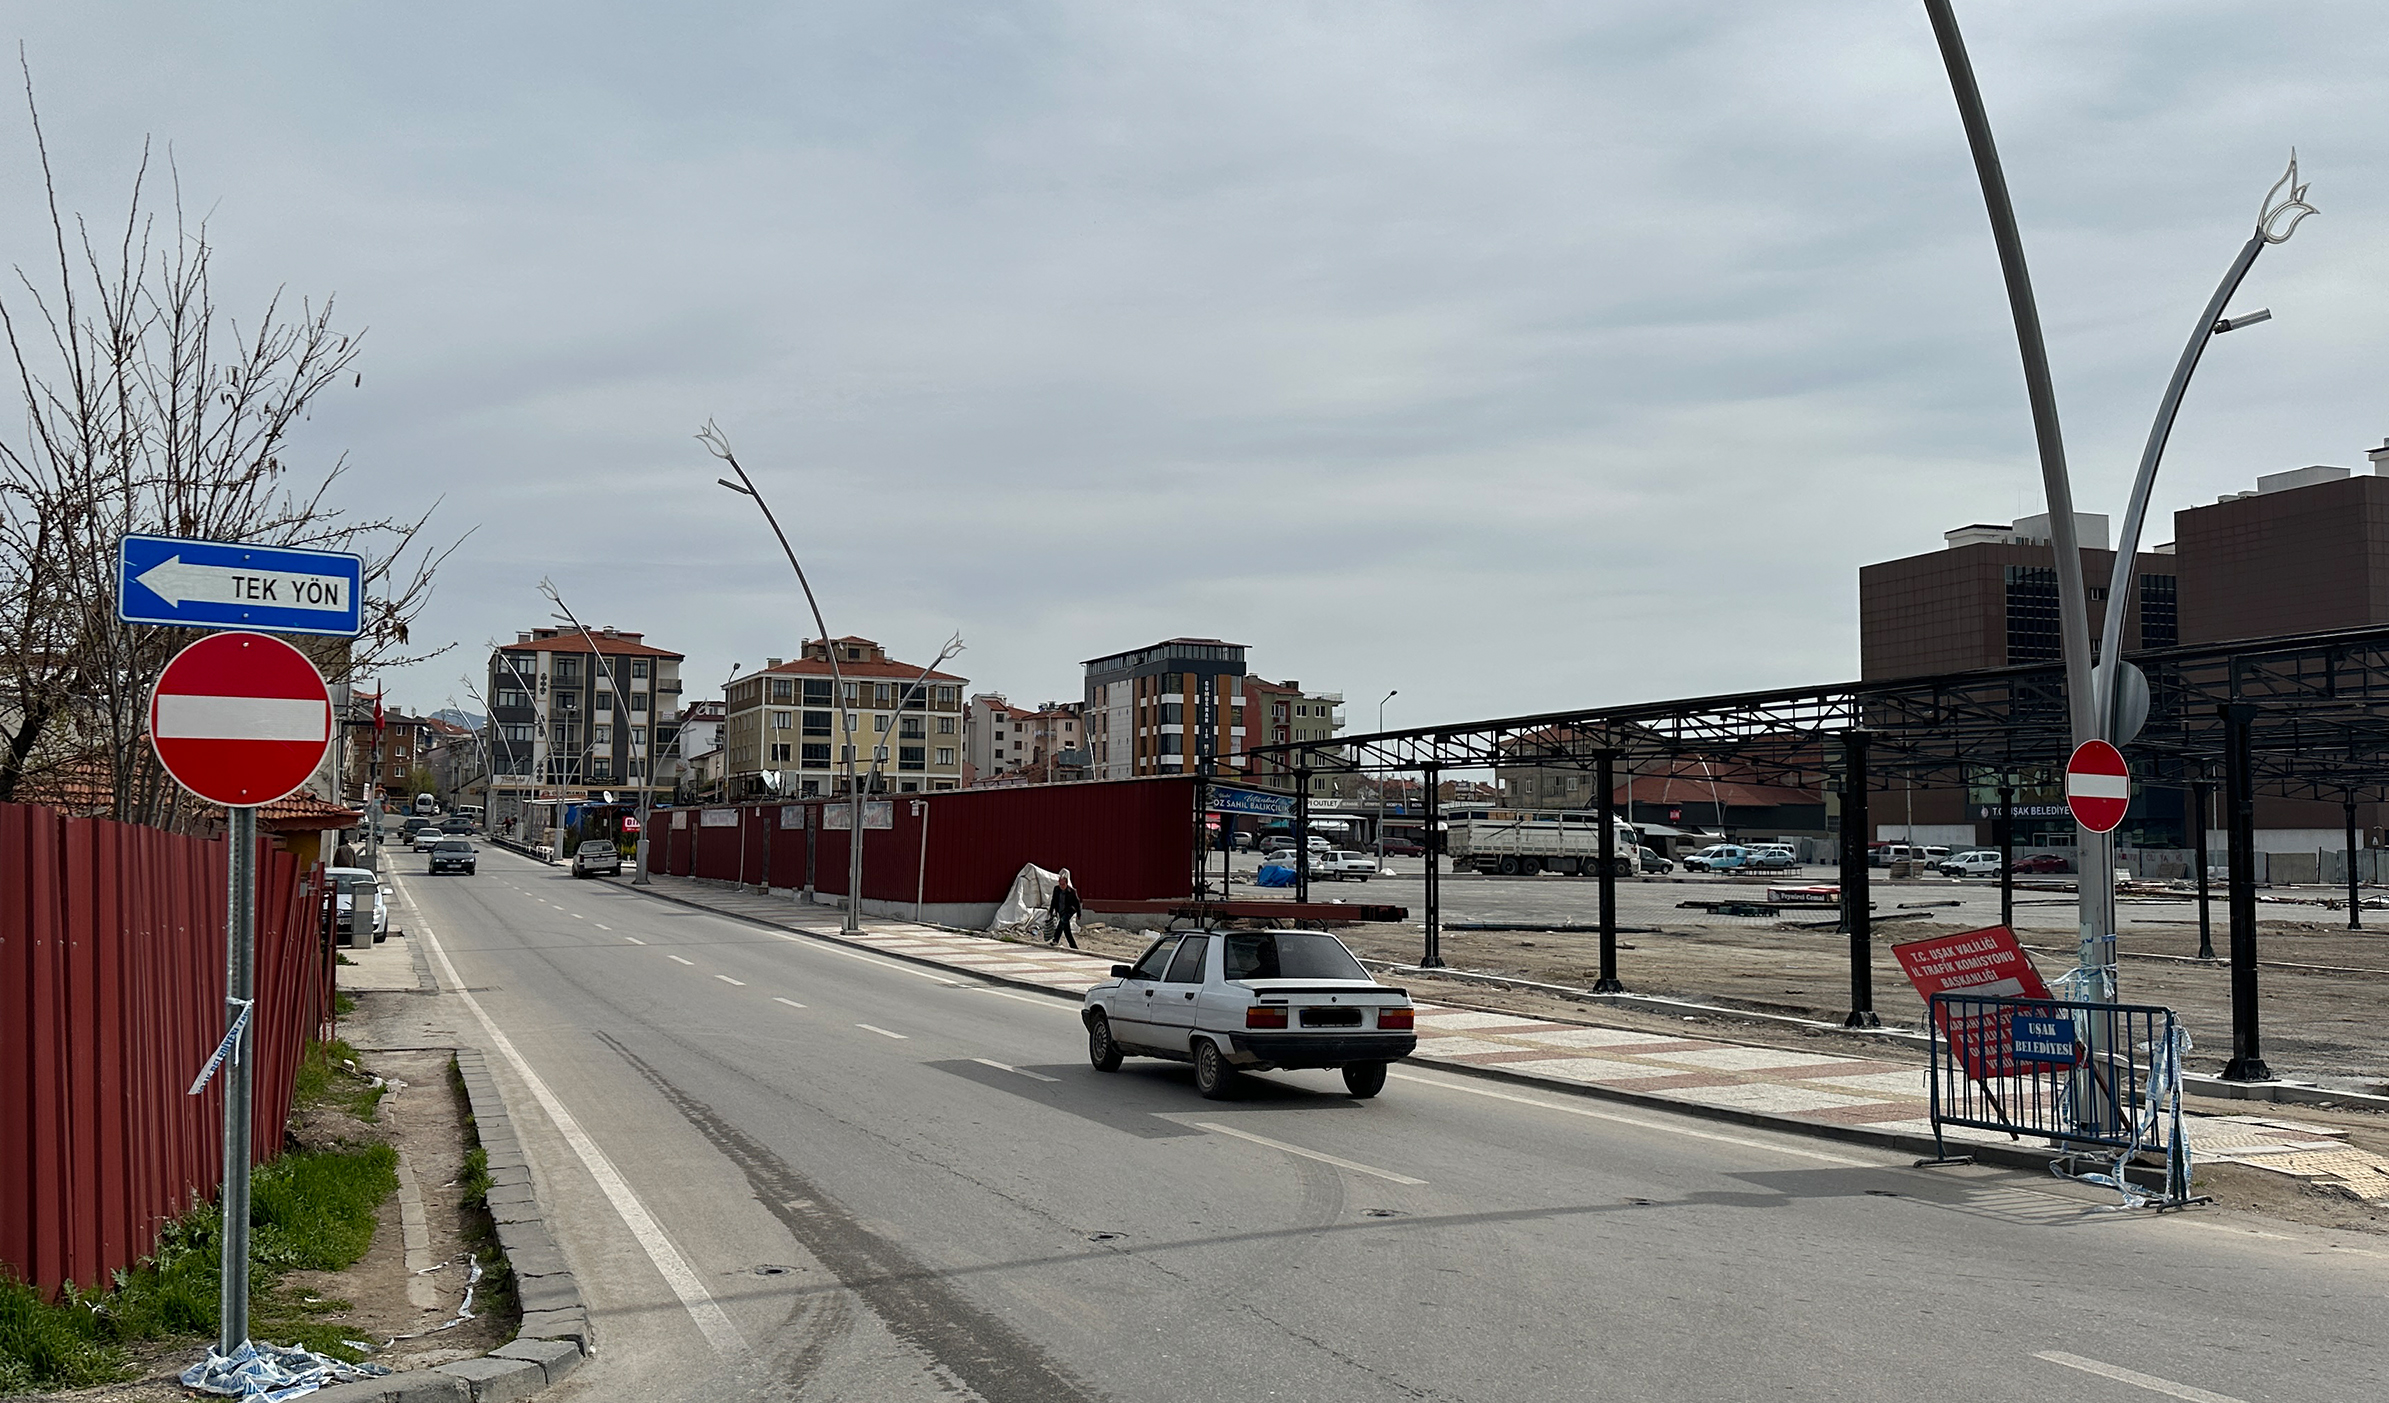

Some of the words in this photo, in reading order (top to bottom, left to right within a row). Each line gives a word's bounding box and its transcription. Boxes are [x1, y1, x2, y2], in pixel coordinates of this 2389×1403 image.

[231, 575, 277, 601] TEK
[291, 577, 338, 605] YÖN
[1226, 800, 1248, 809] SAHİL
[2011, 806, 2029, 818] ŞAK
[2031, 804, 2069, 815] BELEDİYE
[1910, 952, 1930, 963] T.C.
[1930, 946, 1957, 963] UŞAK
[1955, 935, 1998, 955] VALİLİĞİ
[1910, 965, 1923, 978] İL
[1922, 961, 1957, 976] TRAFİK
[1955, 950, 2016, 969] KOMİSYONU
[1940, 969, 1999, 988] BAŞKANLIĞI
[2028, 1022, 2056, 1038] UŞAK
[2015, 1040, 2073, 1056] BELEDİYESİ
